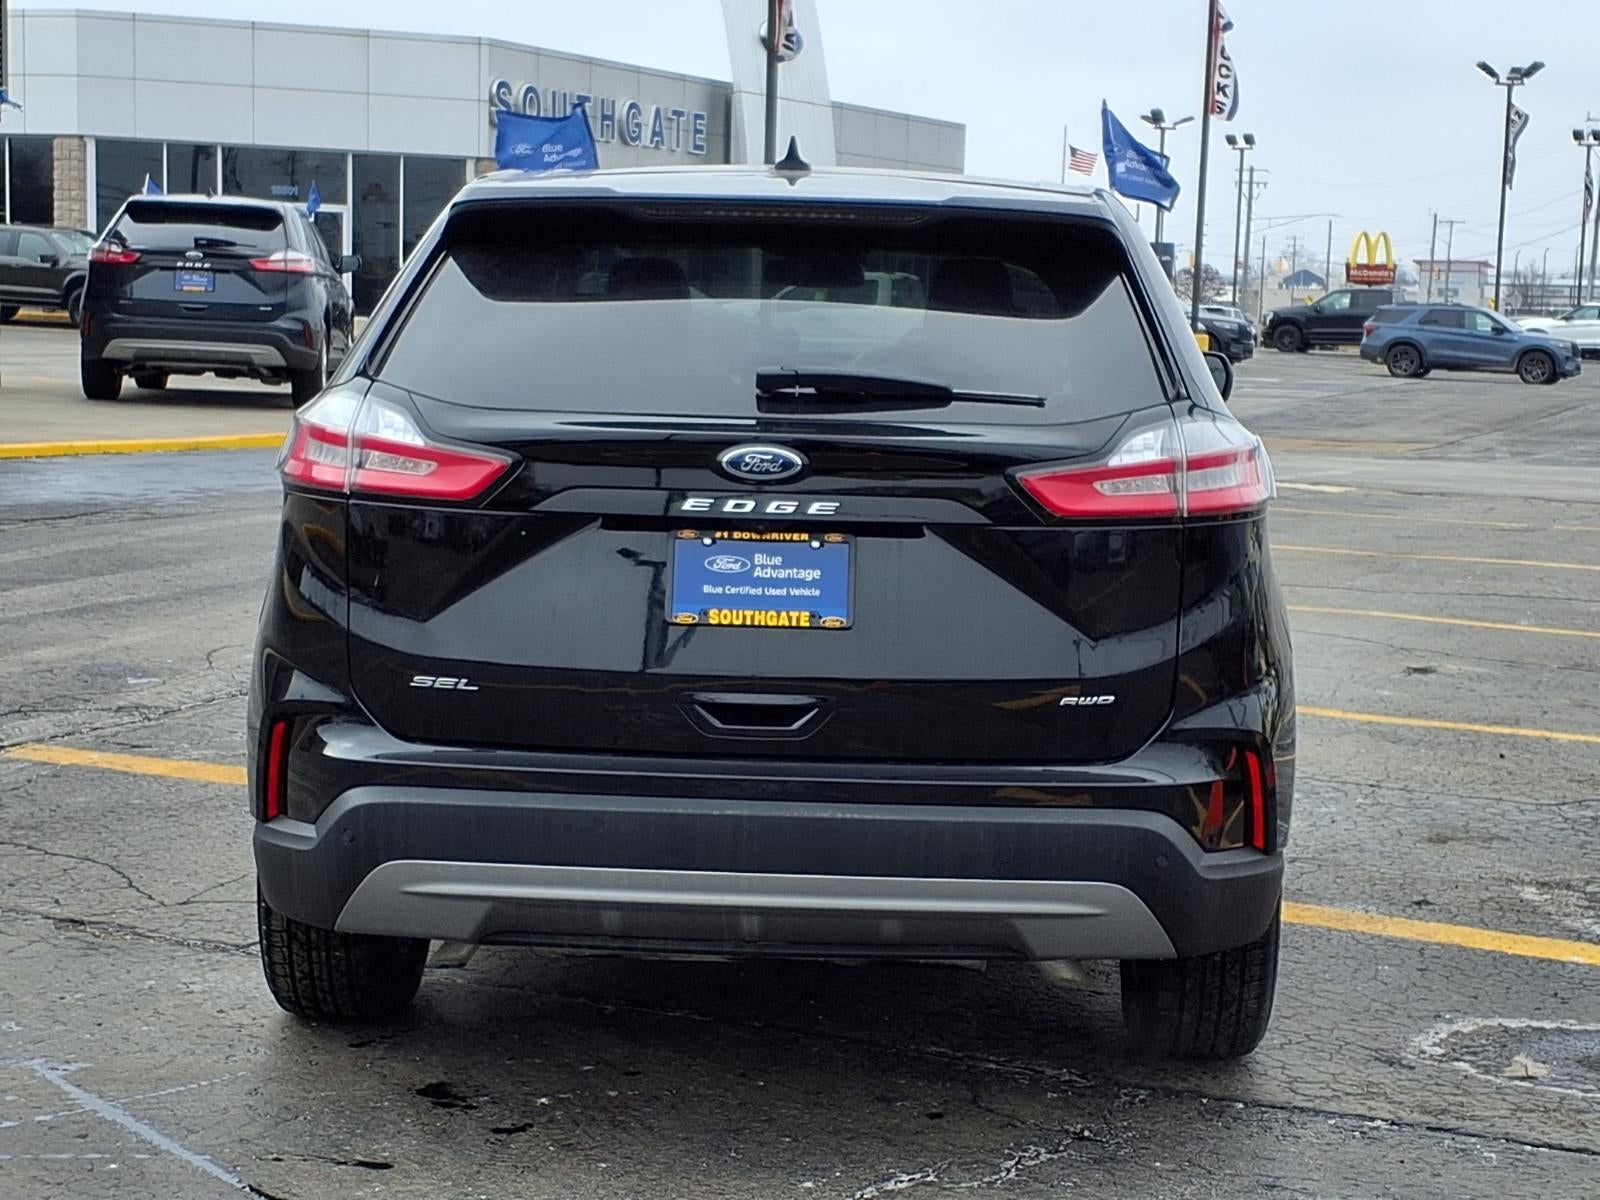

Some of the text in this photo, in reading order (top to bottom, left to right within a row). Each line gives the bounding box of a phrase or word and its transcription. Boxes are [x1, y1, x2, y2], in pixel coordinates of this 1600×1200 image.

[740, 453, 783, 473] Ford
[681, 498, 841, 515] EDGE
[712, 557, 742, 571] Ford
[754, 553, 783, 566] Blue
[753, 566, 821, 581] Advantage
[703, 584, 821, 597] Blue Certified Used Vehicle
[708, 608, 811, 627] SOUTHGATE
[409, 675, 480, 690] SEL
